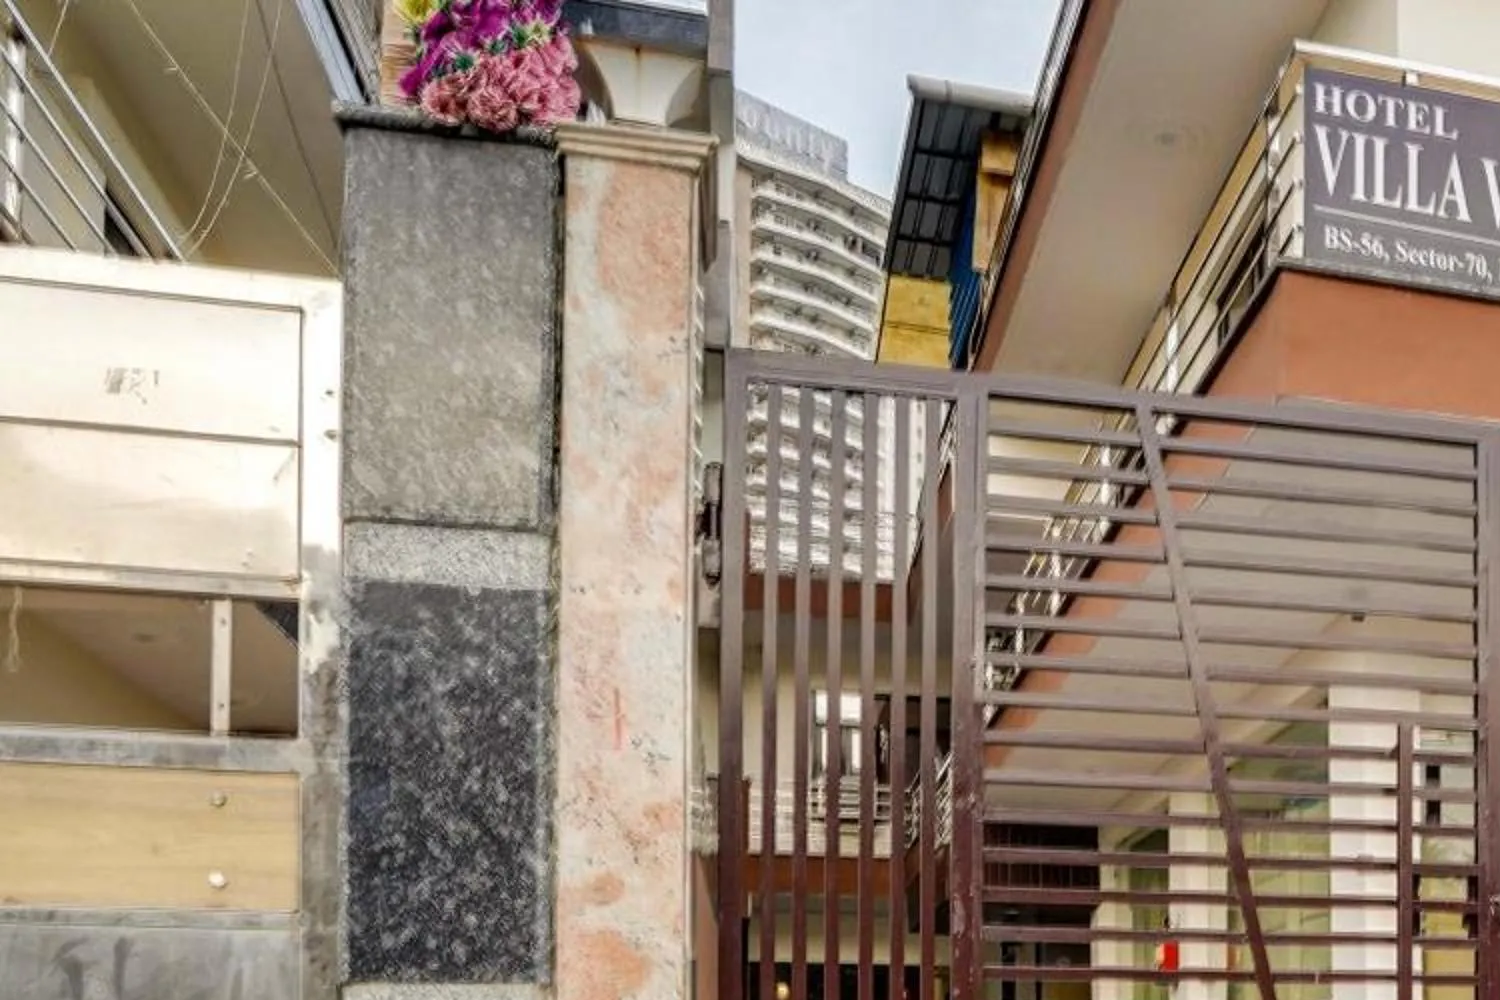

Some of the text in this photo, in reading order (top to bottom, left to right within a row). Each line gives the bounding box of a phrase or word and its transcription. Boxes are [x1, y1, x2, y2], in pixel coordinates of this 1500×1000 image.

[1313, 81, 1459, 141] HOTEL
[1313, 124, 1473, 224] VILLA
[1323, 224, 1389, 262] BS-56,
[1396, 241, 1493, 285] Sector-70,
